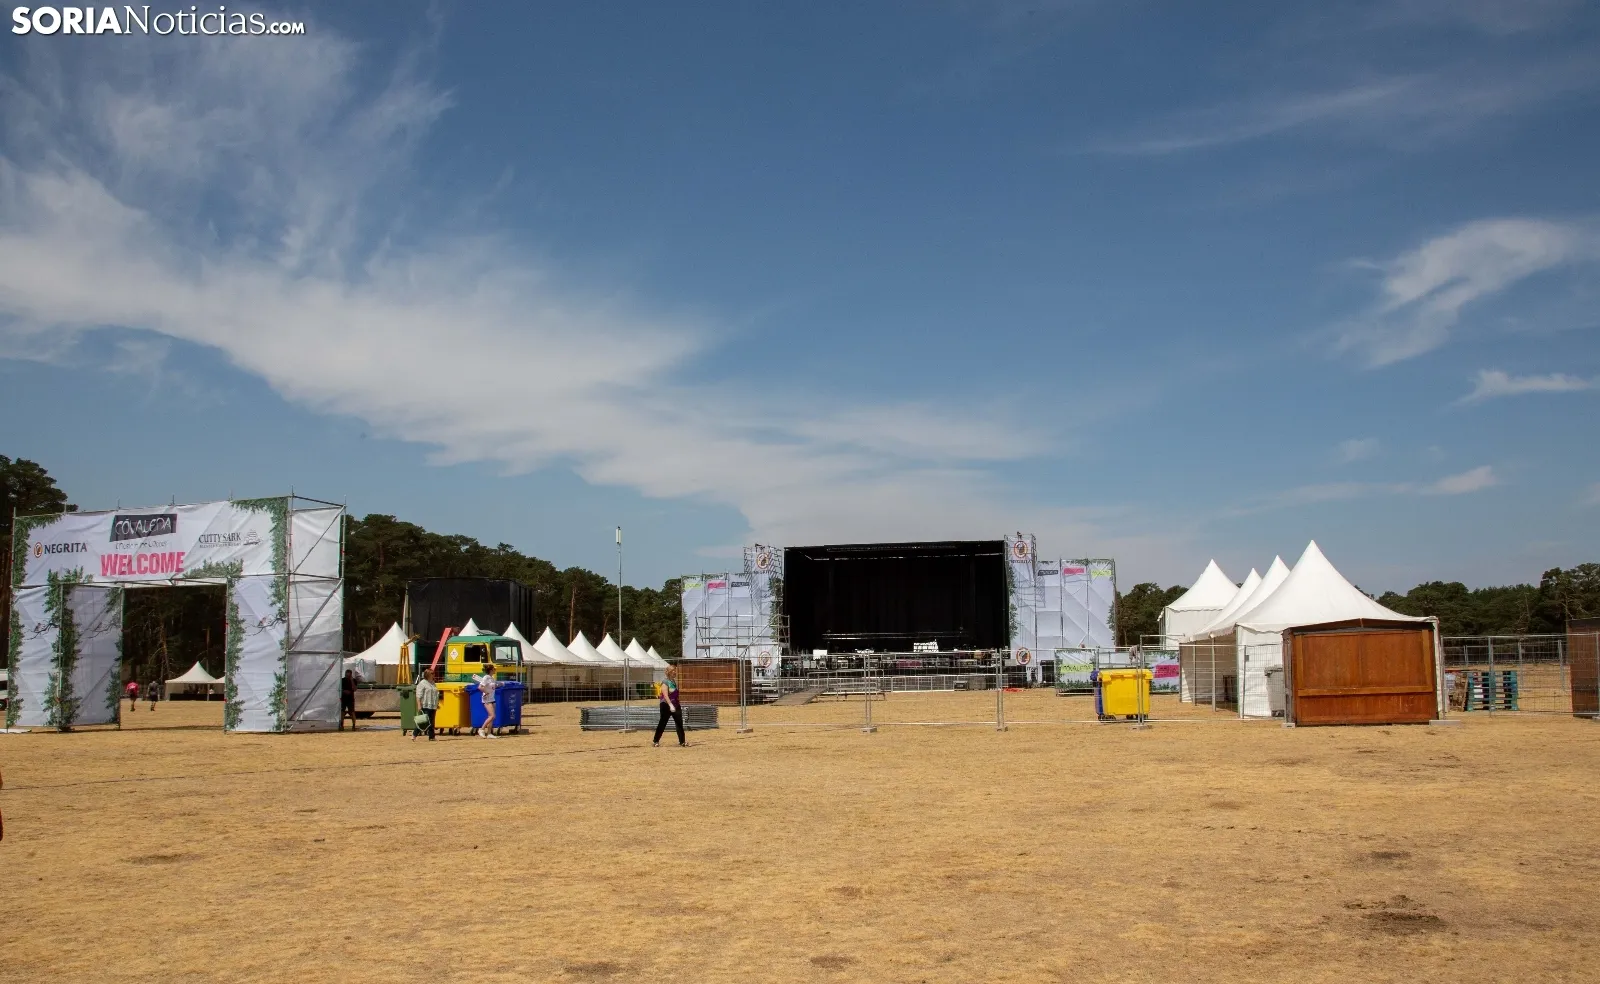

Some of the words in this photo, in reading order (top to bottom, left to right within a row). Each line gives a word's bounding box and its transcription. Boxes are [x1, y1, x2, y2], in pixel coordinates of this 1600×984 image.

[222, 532, 241, 542] SARK
[44, 542, 88, 555] NEGRITA
[100, 551, 186, 577] WELCOME
